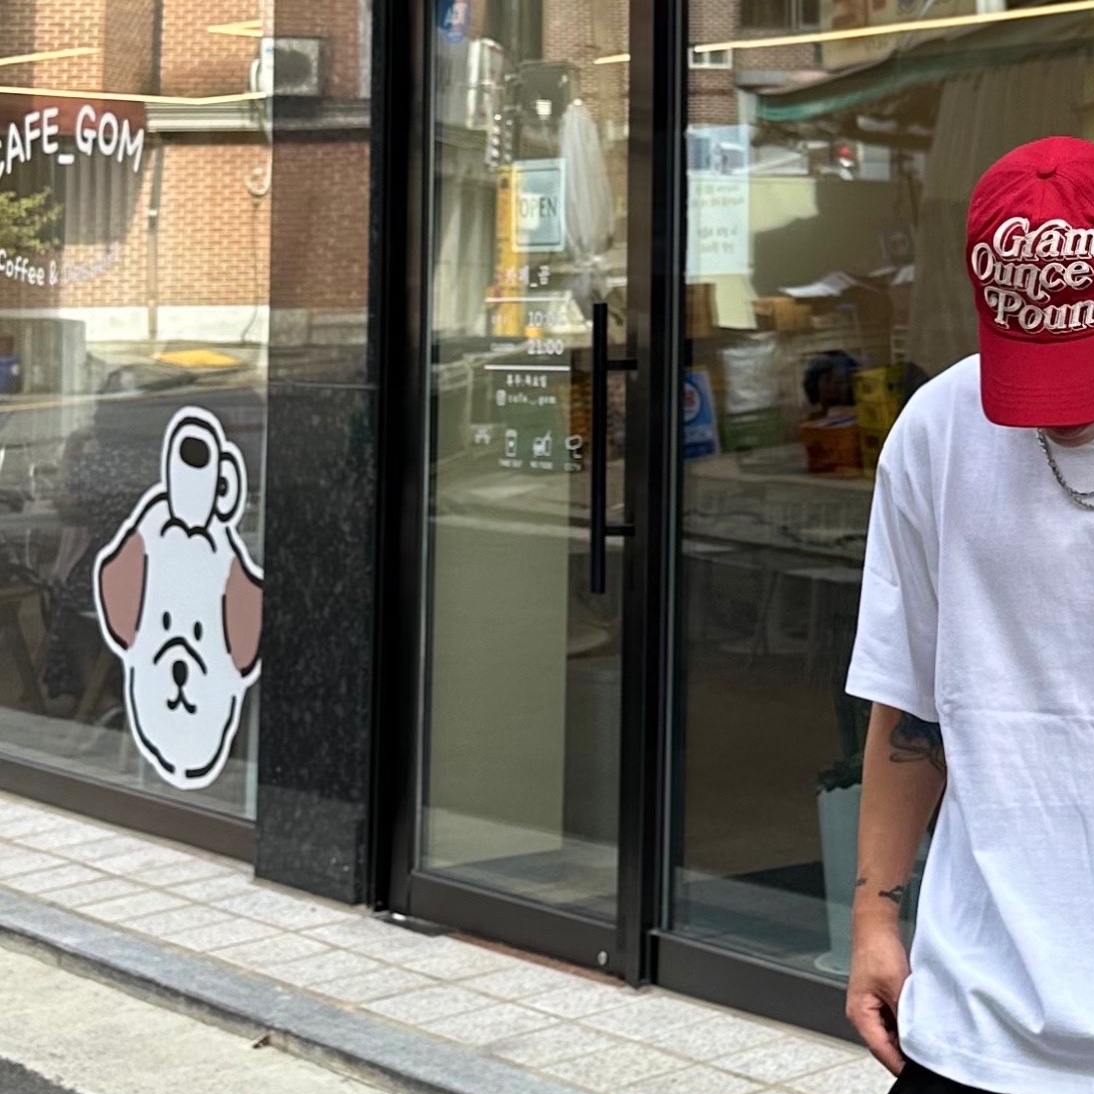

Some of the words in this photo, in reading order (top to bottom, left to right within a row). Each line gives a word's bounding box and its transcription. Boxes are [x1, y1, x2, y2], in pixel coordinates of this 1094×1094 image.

[519, 196, 558, 218] OPEN
[0, 248, 45, 286] Coffee
[49, 260, 58, 286] &
[971, 242, 1094, 304] Ounce
[527, 339, 564, 355] 21:00
